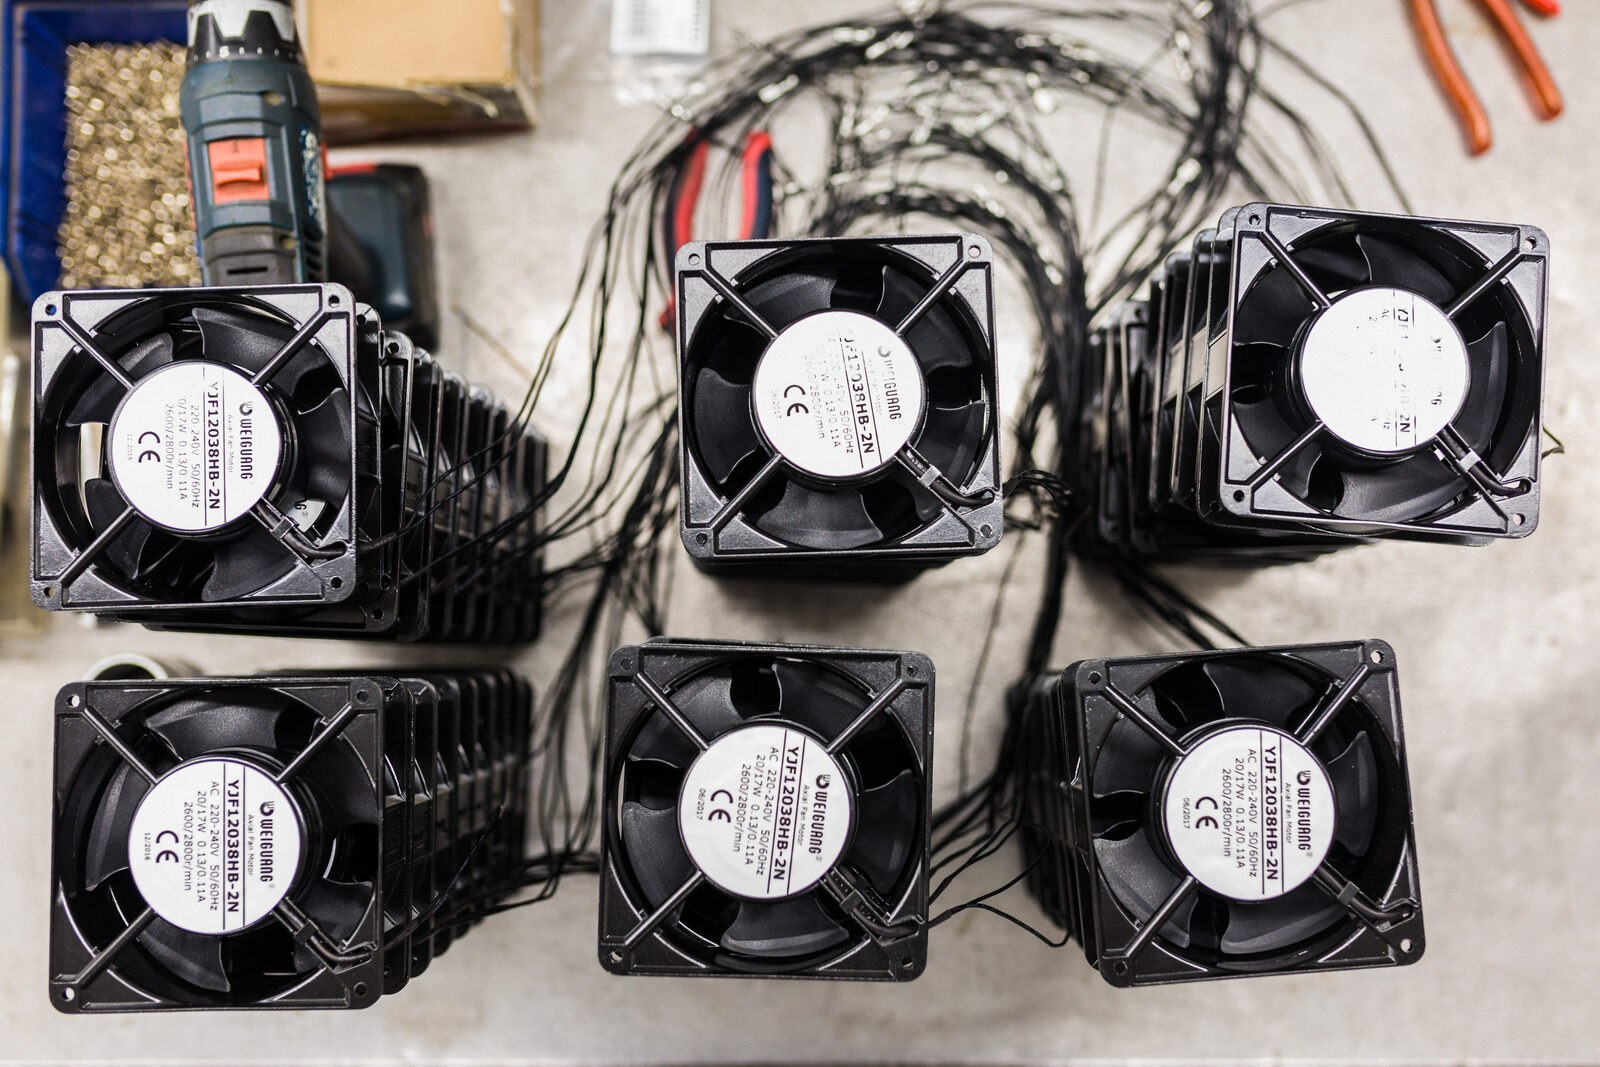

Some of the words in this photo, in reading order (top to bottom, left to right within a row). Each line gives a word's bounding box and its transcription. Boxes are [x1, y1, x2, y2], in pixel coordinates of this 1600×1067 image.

[178, 397, 187, 432] 0/17W
[844, 330, 874, 454] JF12038HB-2N
[165, 404, 174, 489] 2600/2800r/min
[208, 382, 220, 509] YJF12038HB-2N
[240, 419, 253, 479] WEIGUANG
[191, 464, 200, 508] 50/60Hz
[753, 755, 765, 797] 20/17W
[769, 747, 779, 761] AC
[1235, 758, 1244, 800] 20/17W
[1248, 749, 1257, 763] AC
[197, 791, 206, 832] 20/17W
[210, 781, 219, 795] AC
[696, 788, 706, 820] 06/2017
[733, 764, 751, 852] 2600/2800r/min
[763, 770, 777, 822] 220-240V
[773, 747, 799, 880] YJF12038HB-2N
[800, 807, 808, 820] Fan
[802, 785, 810, 804] Axial
[1222, 769, 1232, 857] 2600/2800r/min
[1249, 772, 1258, 824] 220-240V
[1265, 746, 1278, 880] YJF12038HB-2N
[210, 804, 219, 857] 220-240V
[745, 805, 760, 865] 0.13/0.11A
[798, 824, 806, 846] Motor
[809, 791, 827, 854] WEIGUANG
[1235, 808, 1245, 868] 0.13/0.11A
[1297, 788, 1311, 851] WEIGUANG
[183, 802, 193, 891] 2600/2800r/min
[197, 841, 206, 902] 0.13/0.11A
[227, 780, 239, 912] YJF12038HB-2N
[260, 819, 274, 882] WEIGUANG
[756, 830, 770, 876] 50/60Hz
[1249, 832, 1258, 877] 50/60Hz
[210, 865, 219, 911] 50/60Hz
